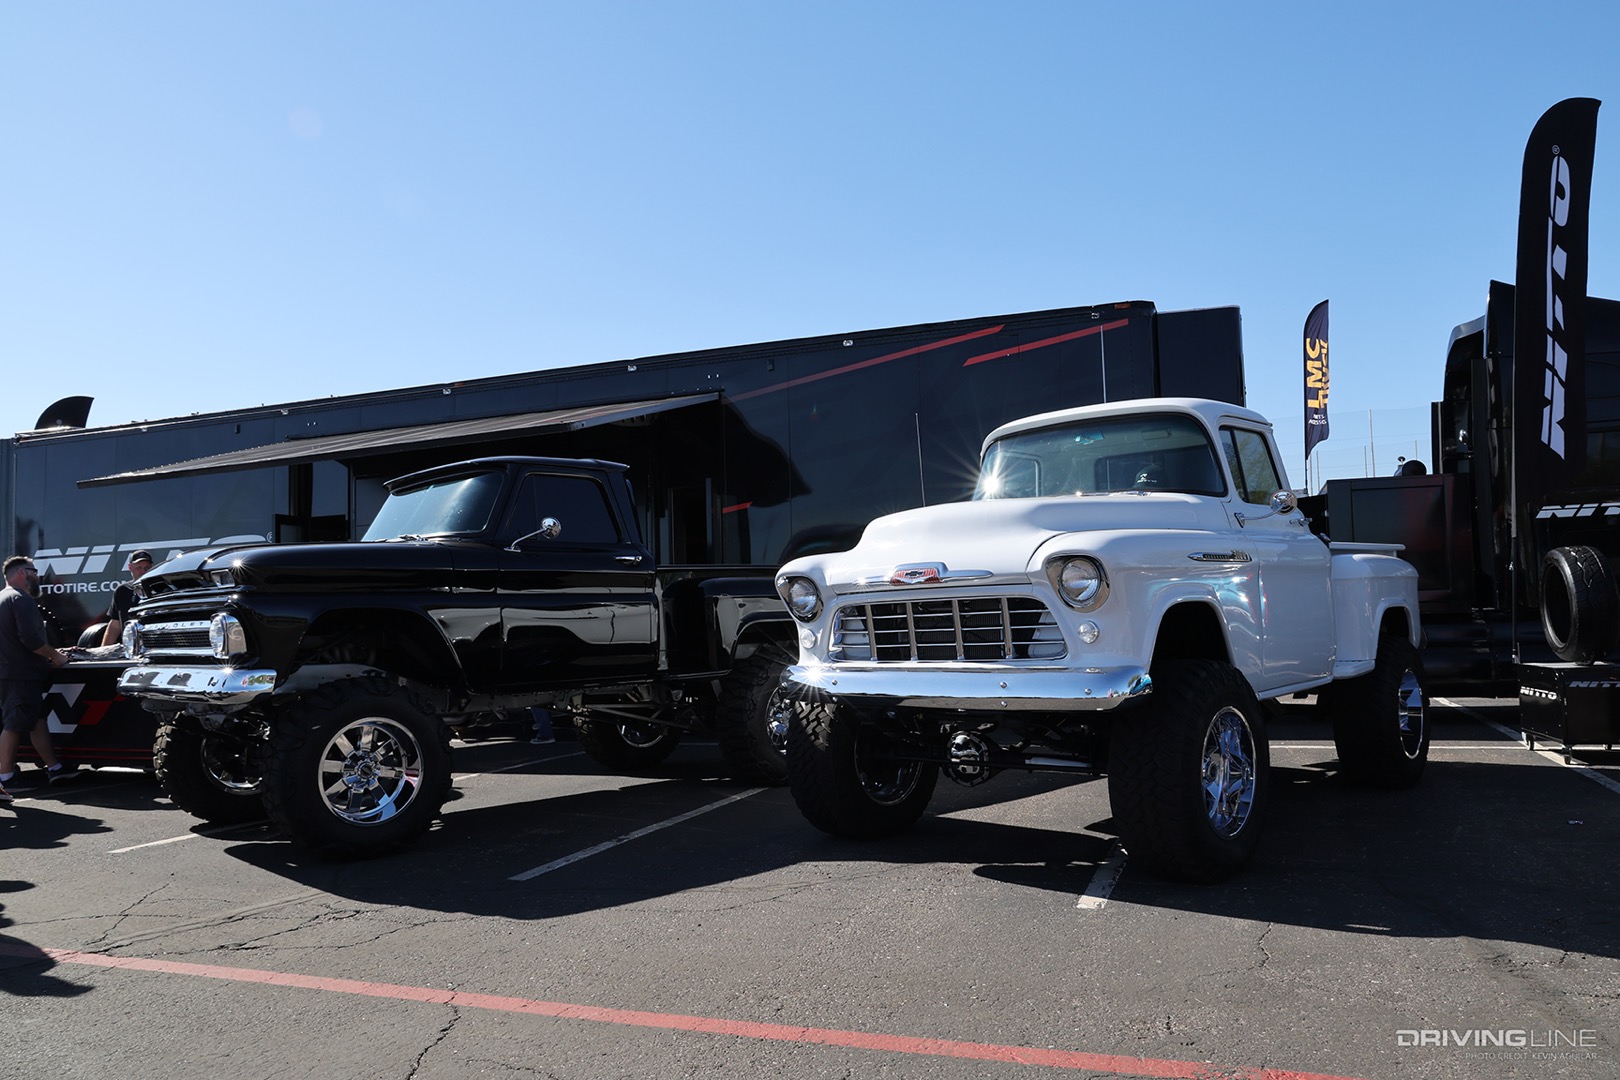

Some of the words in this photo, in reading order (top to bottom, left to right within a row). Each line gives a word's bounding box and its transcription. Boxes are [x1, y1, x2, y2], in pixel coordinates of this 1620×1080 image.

[1541, 155, 1571, 460] NITTO
[1306, 337, 1323, 408] LMC
[39, 580, 127, 594] TTOTIRE.CO
[1519, 685, 1557, 700] NITTO
